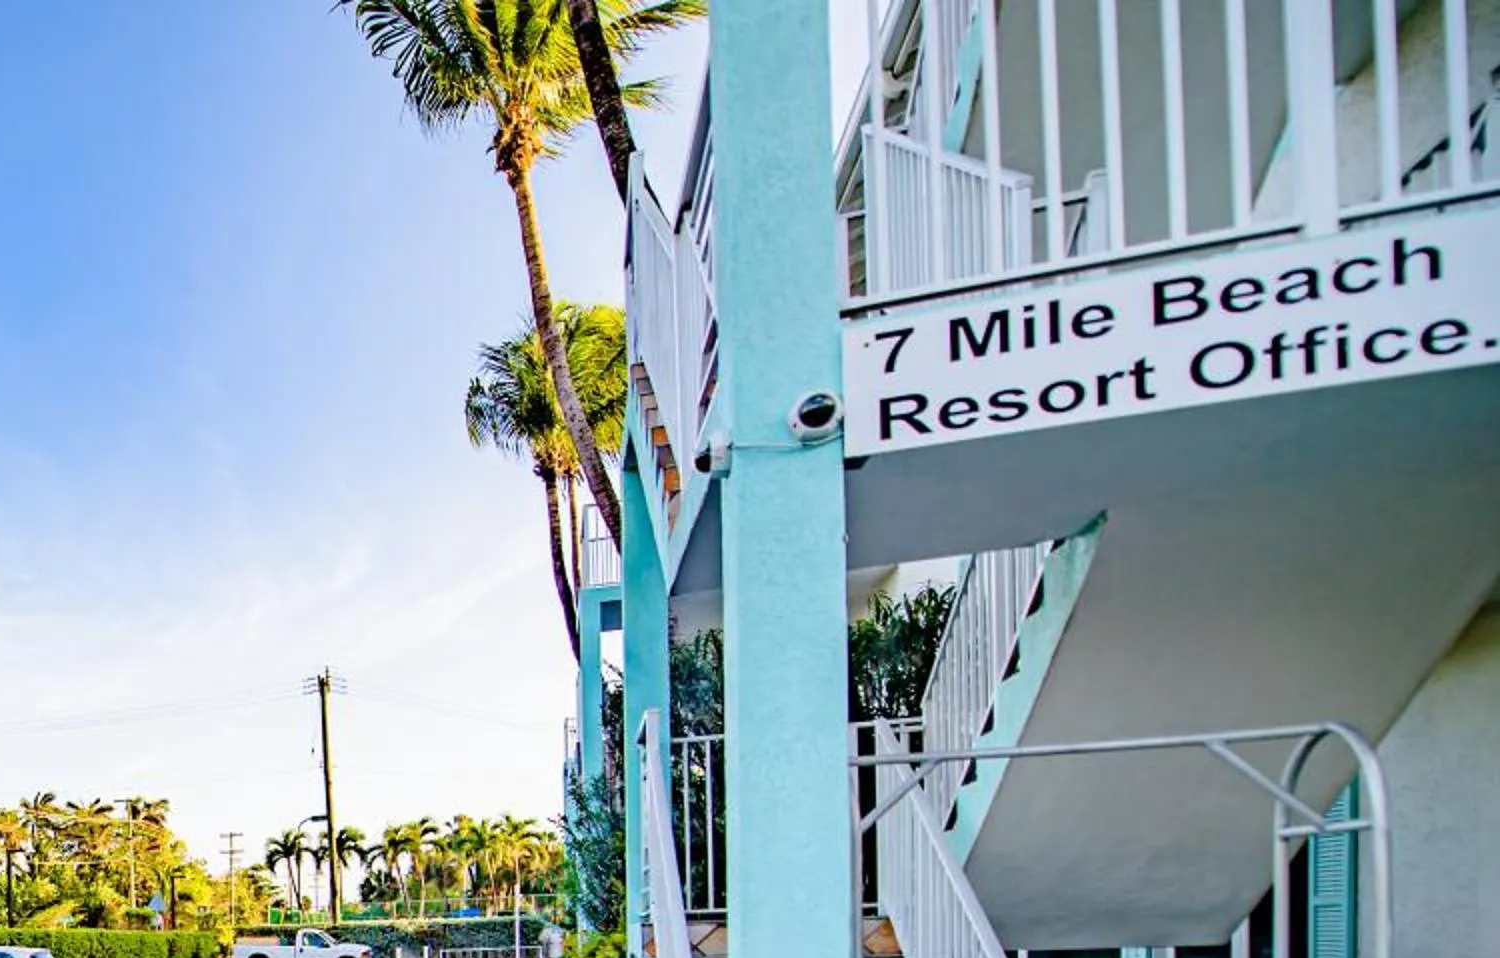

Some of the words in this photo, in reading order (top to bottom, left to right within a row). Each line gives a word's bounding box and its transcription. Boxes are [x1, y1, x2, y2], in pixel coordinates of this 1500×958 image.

[875, 327, 915, 374] 7
[949, 299, 1115, 362] Mile
[1153, 238, 1441, 327] Beach
[879, 357, 1156, 441] Resort
[1189, 319, 1498, 389] Office.
